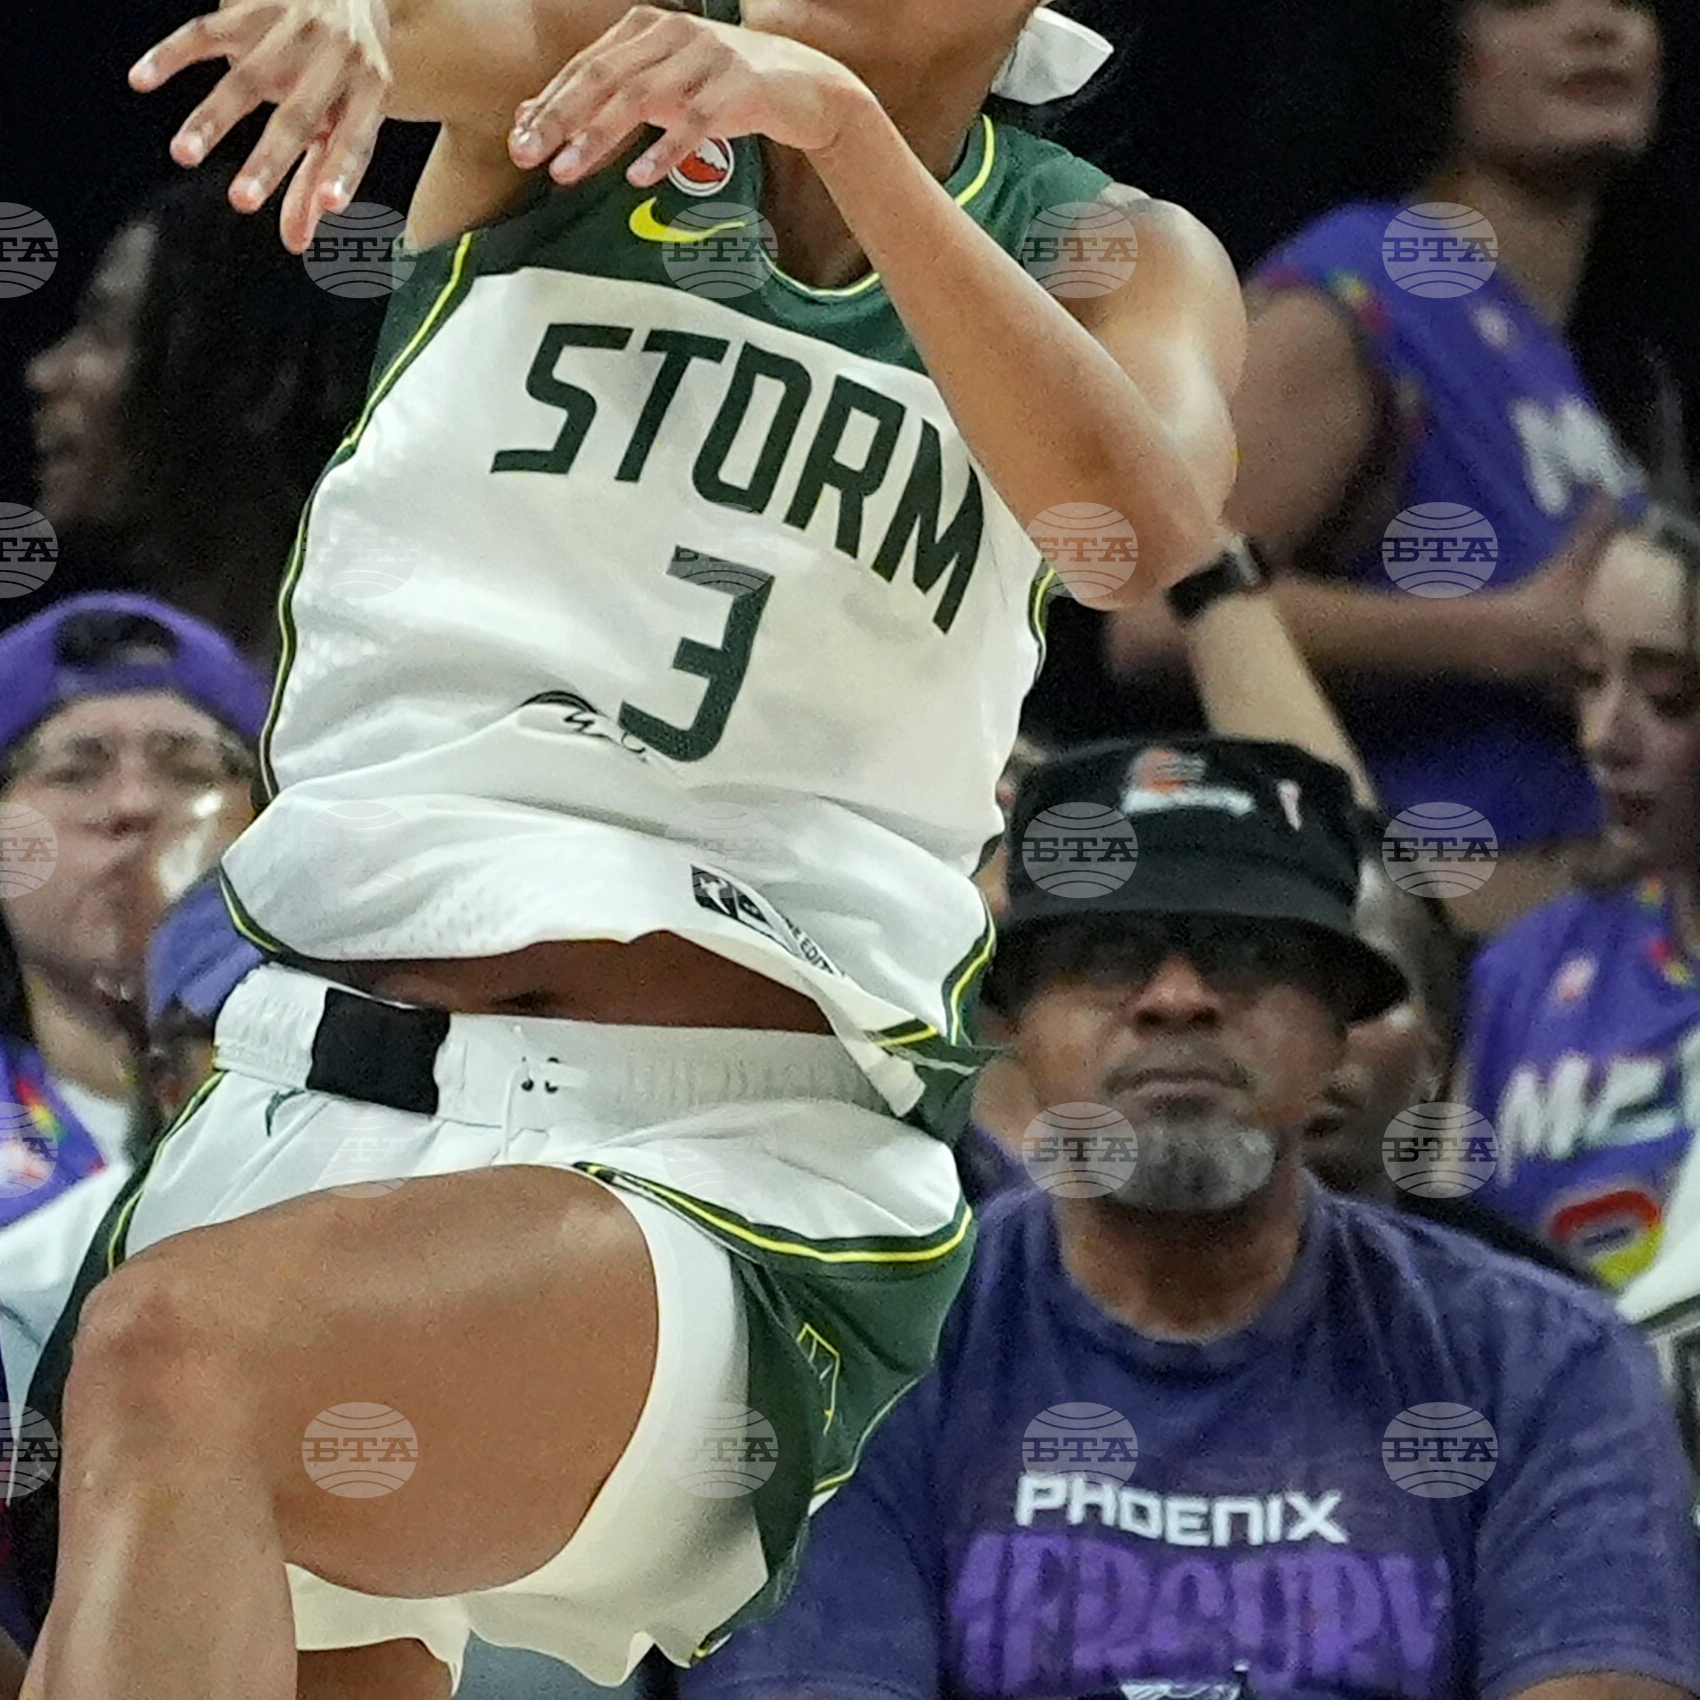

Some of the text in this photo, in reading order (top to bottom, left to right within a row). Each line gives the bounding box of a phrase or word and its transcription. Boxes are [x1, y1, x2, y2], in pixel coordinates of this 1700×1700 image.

[489, 322, 986, 635] STORM
[616, 544, 776, 763] 3
[1013, 1470, 1349, 1547] PHOENIX
